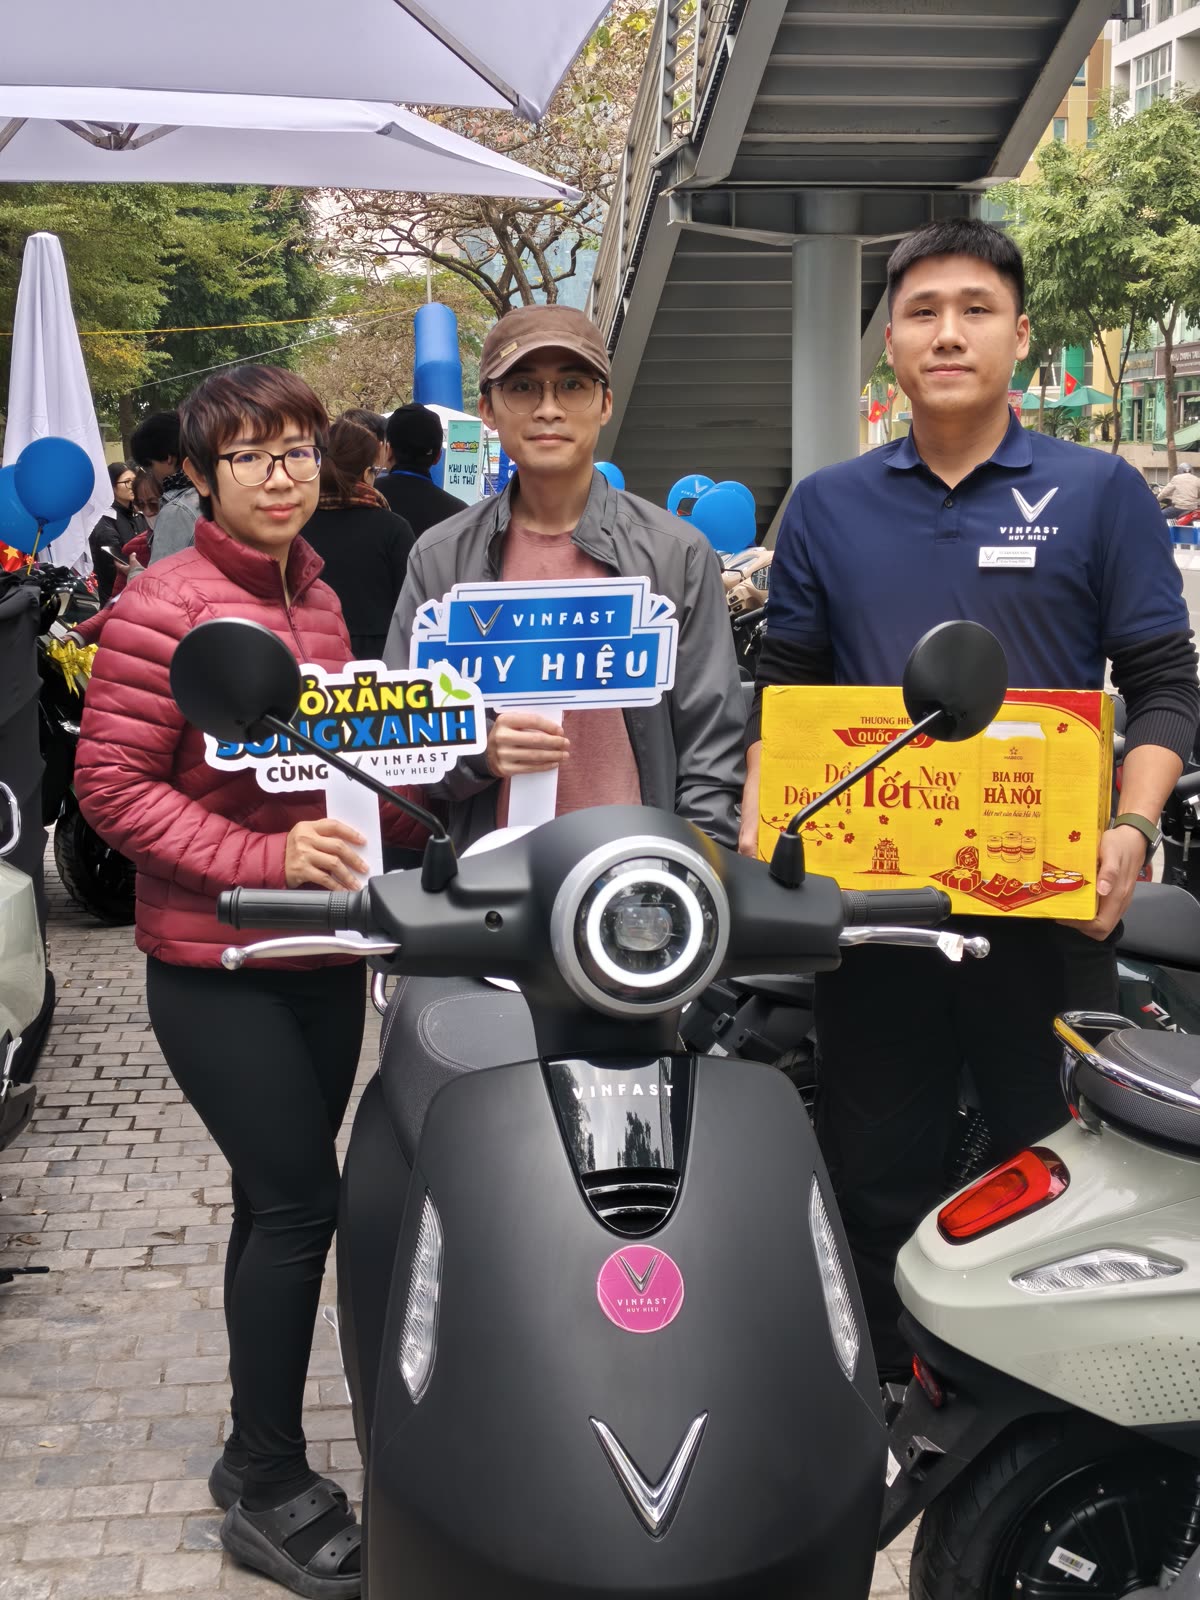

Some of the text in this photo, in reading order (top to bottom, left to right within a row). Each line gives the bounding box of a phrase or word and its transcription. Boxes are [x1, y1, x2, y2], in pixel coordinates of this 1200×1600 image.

[999, 526, 1059, 535] VINFAST
[512, 610, 616, 628] VINFAST
[428, 644, 648, 686] UY HIỆU
[299, 676, 428, 716] Ỏ XĂNG
[350, 709, 477, 748] XANH
[857, 729, 893, 743] QUỐC
[266, 751, 449, 783] CÙNG VINFAST
[385, 766, 436, 777] HUY HIEU
[992, 771, 1011, 782] BIA
[858, 766, 913, 809] Tết
[918, 766, 962, 792] Nay
[983, 784, 1042, 809] HÀ NỘI
[918, 789, 960, 810] Xưa
[572, 1083, 674, 1100] VINFAST
[616, 1297, 668, 1306] VINFAST
